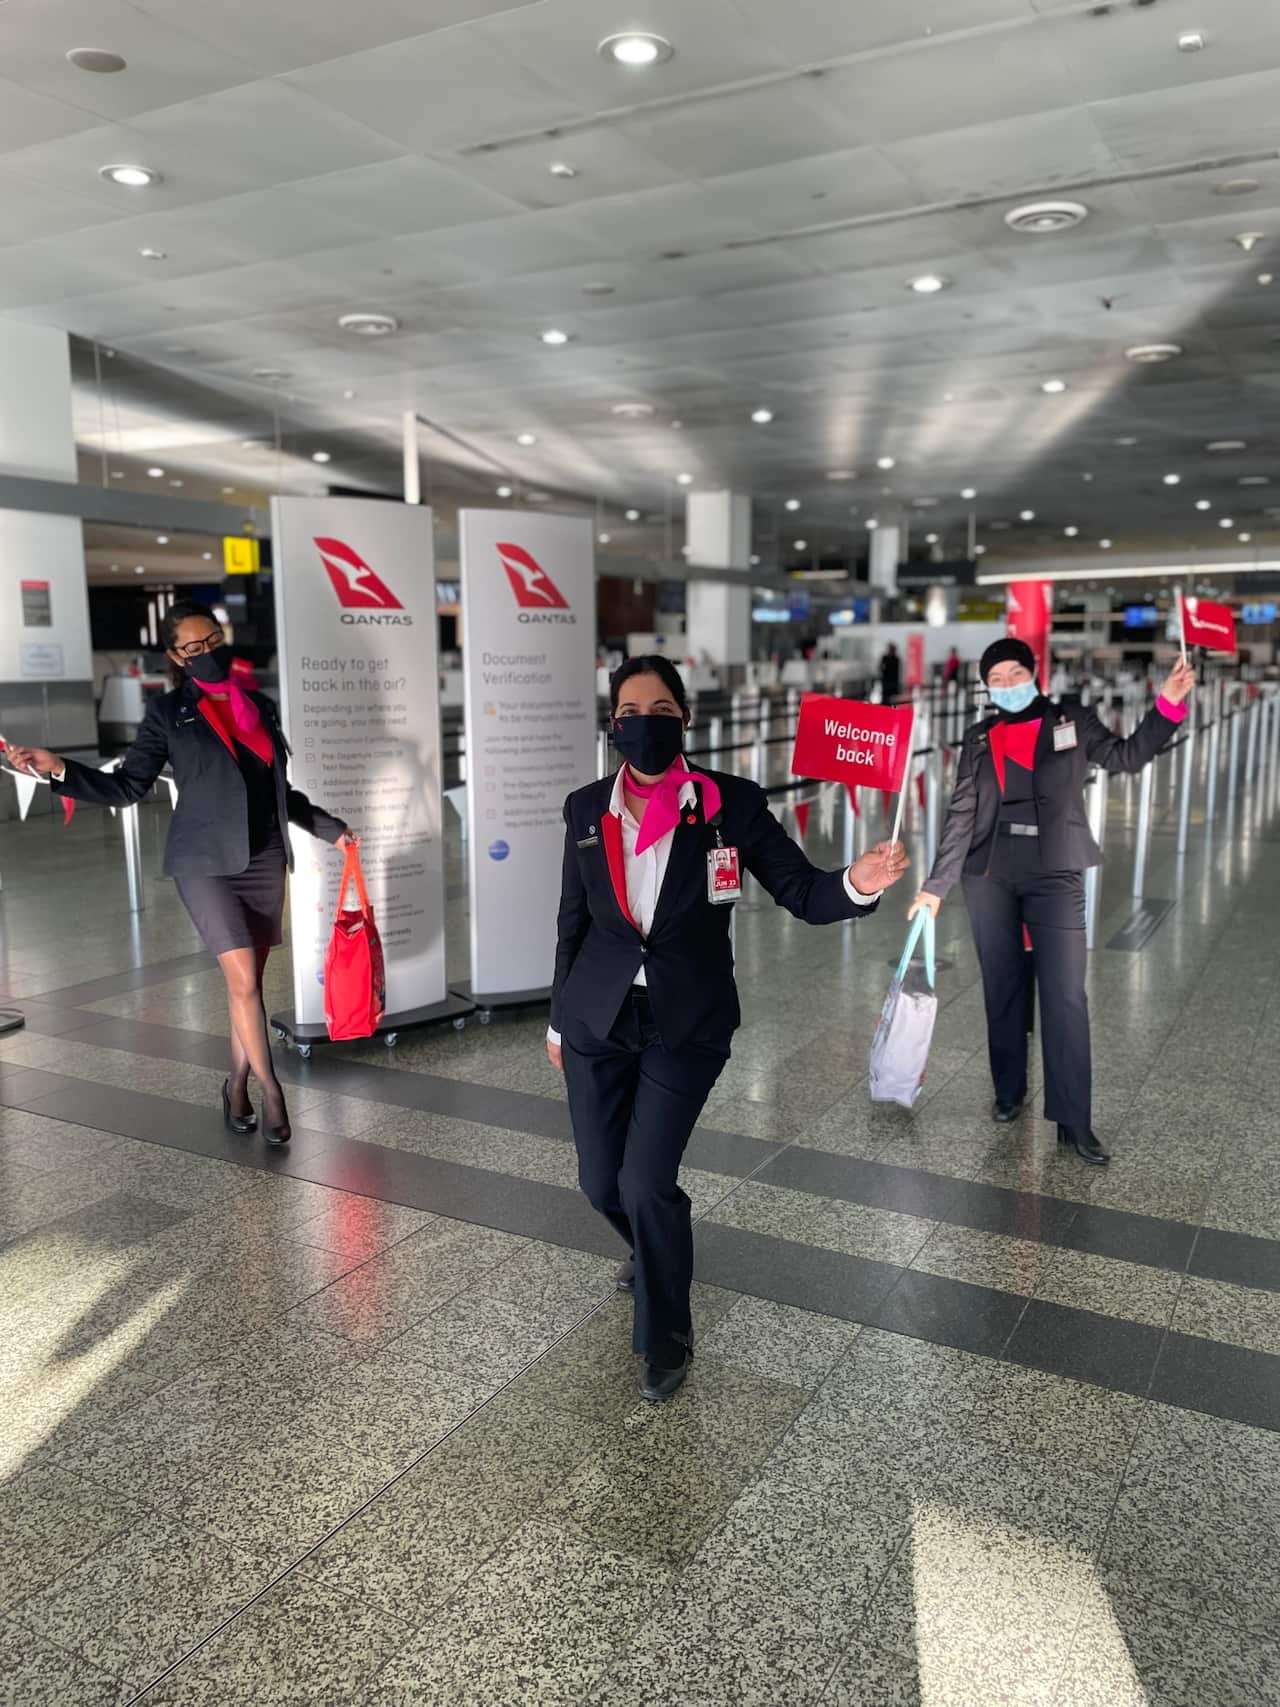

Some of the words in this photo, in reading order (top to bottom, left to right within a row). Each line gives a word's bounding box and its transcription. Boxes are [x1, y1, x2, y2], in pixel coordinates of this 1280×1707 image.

[231, 543, 245, 567] L
[340, 614, 414, 626] QANTAS
[517, 613, 577, 625] QANTAS
[301, 657, 347, 673] Ready
[351, 658, 365, 671] to
[368, 658, 389, 673] get
[482, 652, 547, 666] Document
[302, 678, 338, 693] back
[342, 678, 355, 692] in
[359, 678, 380, 692] the
[383, 676, 407, 691] air?
[482, 671, 553, 685] Verification
[303, 704, 352, 715] Depending
[304, 719, 319, 729] are
[824, 718, 896, 747] Welcome
[836, 743, 875, 767] back
